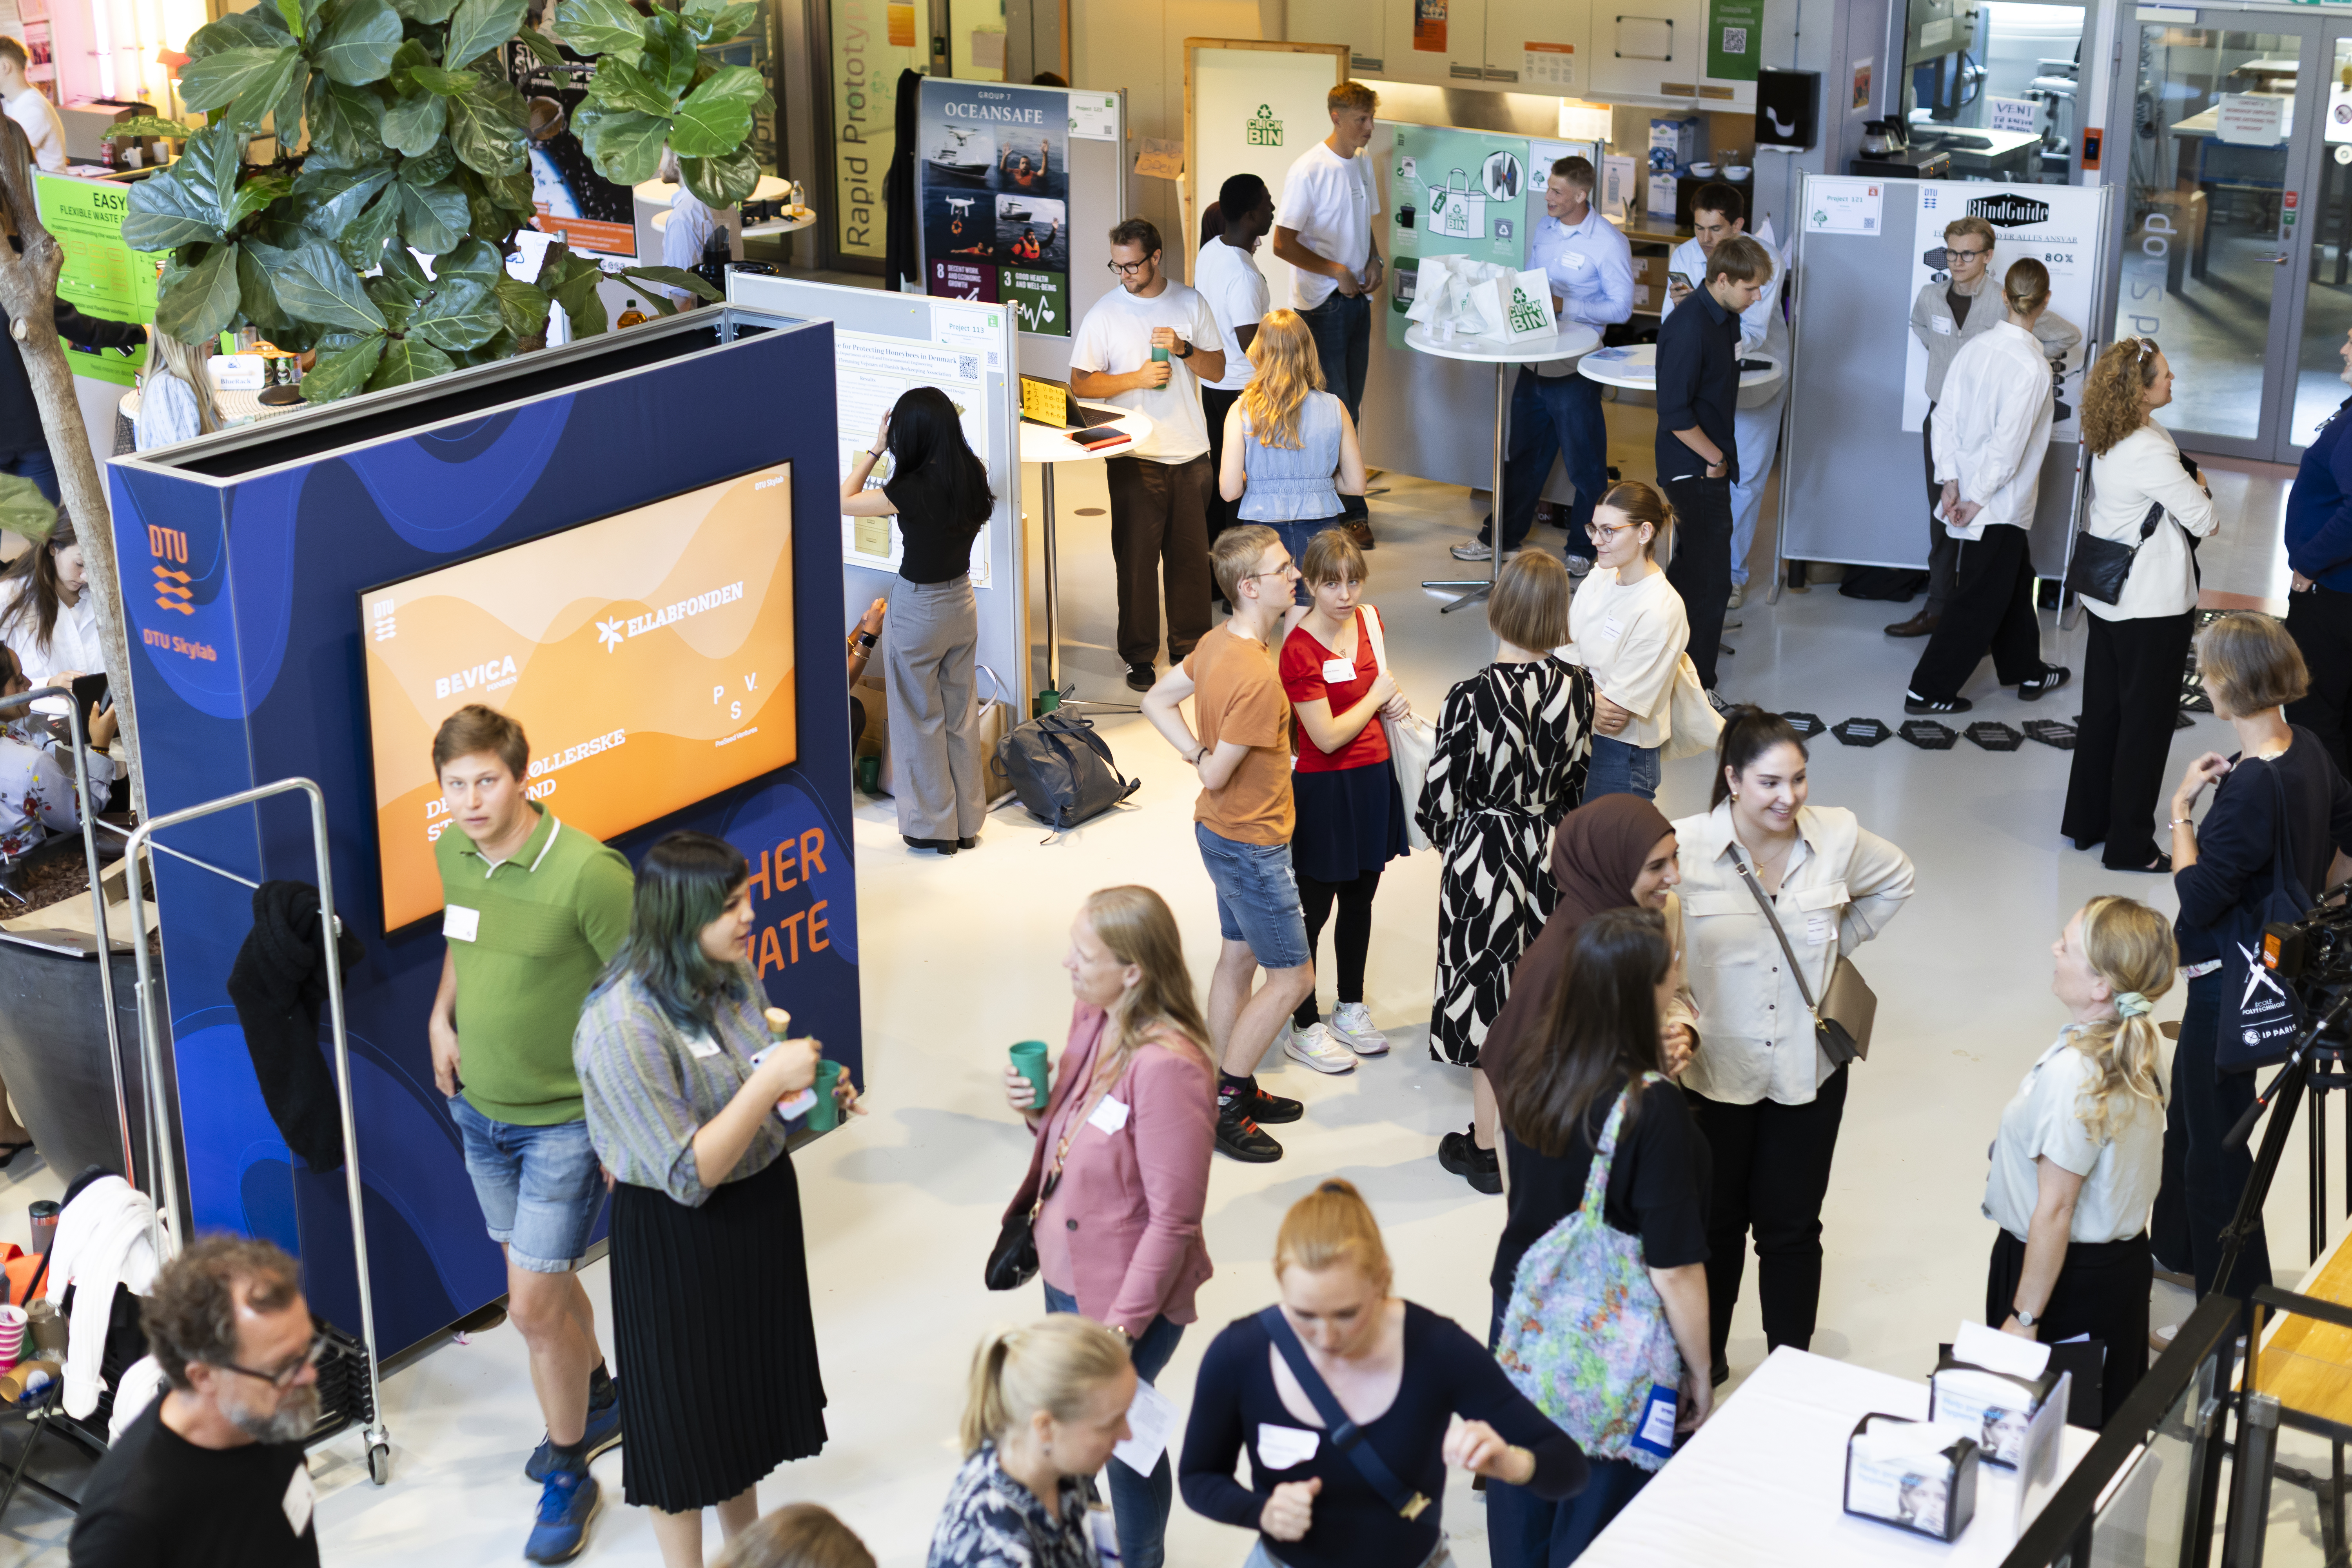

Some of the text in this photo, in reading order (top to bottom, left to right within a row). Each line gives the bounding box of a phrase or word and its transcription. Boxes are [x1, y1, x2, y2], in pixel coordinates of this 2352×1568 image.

[978, 91, 1004, 100] GROUP
[944, 102, 1044, 124] OCEANSAFE
[1997, 102, 2033, 117] VENT
[843, 1, 875, 247] Rapid Prototyp
[1247, 119, 1283, 130] CLICK
[1248, 129, 1282, 145] BIN
[60, 205, 92, 218] FLEXIBLE
[93, 212, 119, 223] WASTE
[1967, 199, 2049, 221] BlindGuide
[1447, 220, 1467, 230] BIN
[2045, 253, 2073, 263] 80%
[936, 263, 944, 278] 8
[1004, 271, 1011, 286] 3
[1015, 272, 1049, 283] GOOD HEALTH
[1027, 281, 1057, 292] WELL-BEING
[1509, 299, 1542, 317] CLICK
[949, 323, 969, 332] Project
[1510, 311, 1548, 333] BIN
[853, 345, 884, 354] Protecting
[886, 349, 919, 358] Honeybees
[929, 354, 957, 364] Denmark
[900, 366, 926, 374] Beekeeping
[755, 481, 766, 490] DTU
[149, 524, 189, 564] DTU
[373, 598, 395, 619] DTU
[627, 581, 744, 638] ELLABFONDEN
[143, 628, 217, 662] DTU Skylab
[436, 655, 517, 699] BEVICA
[486, 675, 517, 692] FONDEN
[713, 685, 724, 704] P
[730, 701, 742, 720] S
[715, 727, 758, 748] PreSeed Ventures
[526, 728, 626, 780] ØLLERSKE
[2242, 1000, 2286, 1015] POLYTECHNIQU
[2273, 1024, 2297, 1037] PARIS
